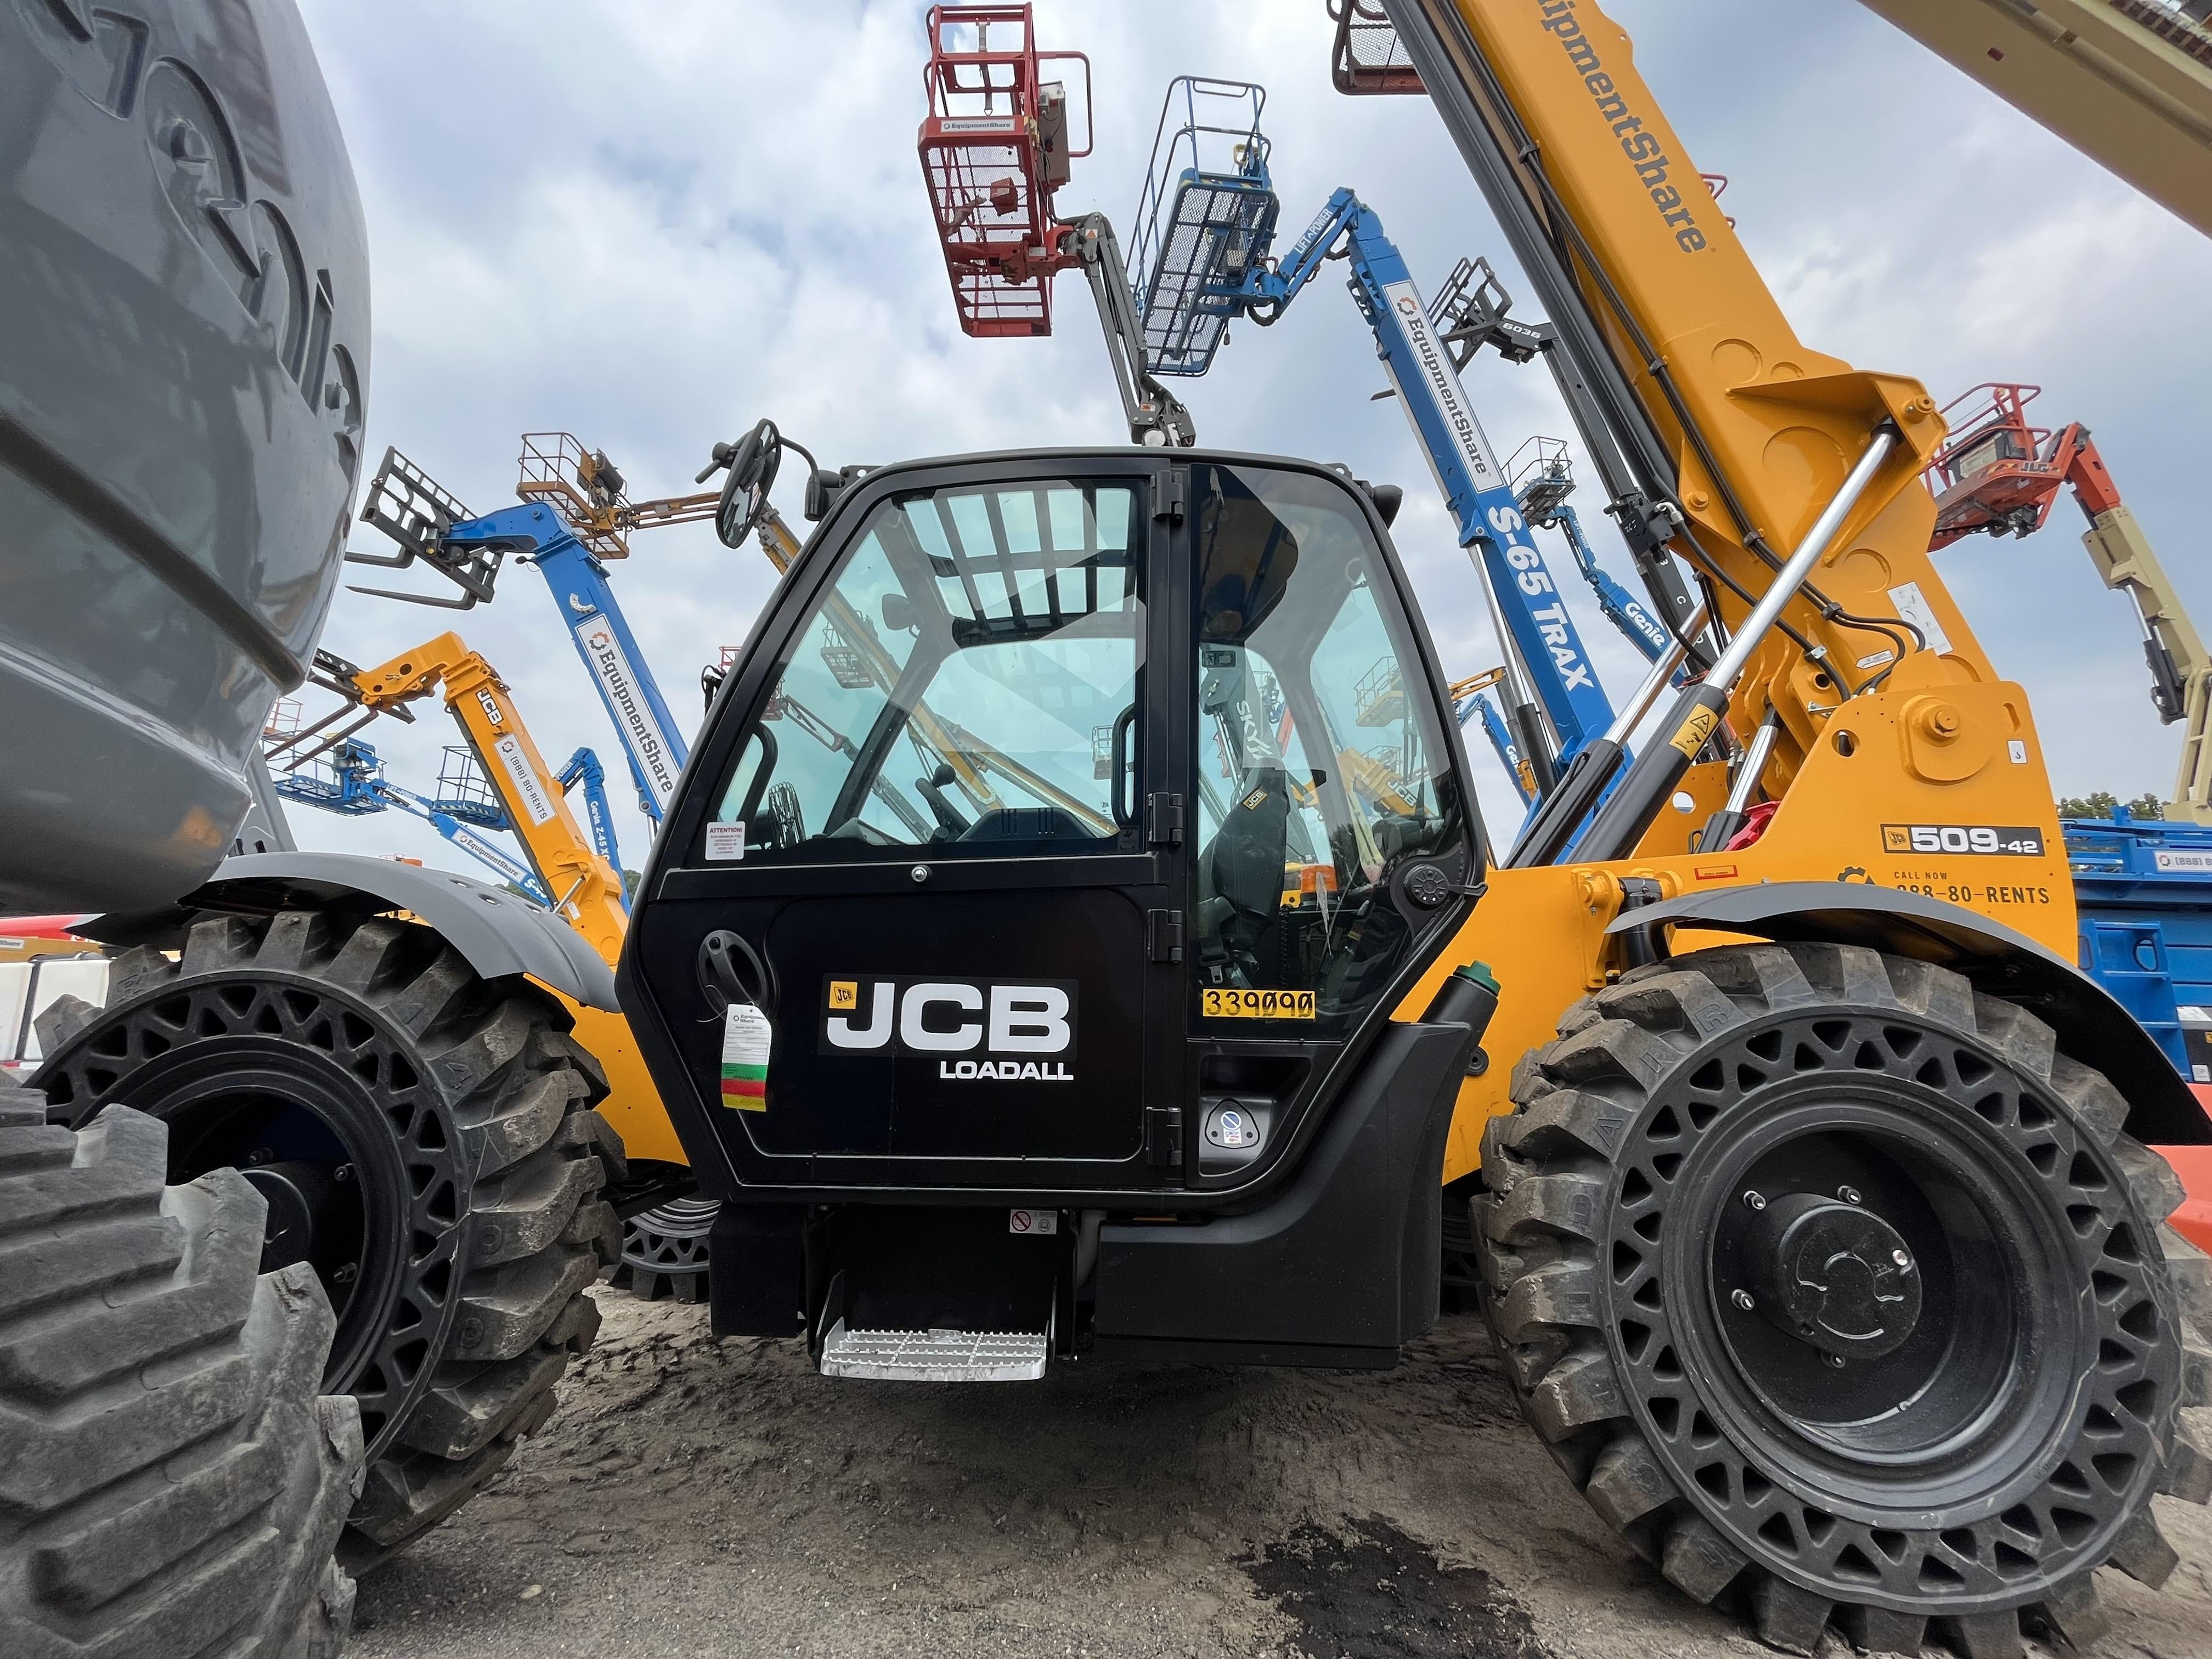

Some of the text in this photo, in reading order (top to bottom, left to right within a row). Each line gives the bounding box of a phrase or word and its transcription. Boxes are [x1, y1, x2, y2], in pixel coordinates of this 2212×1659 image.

[1538, 0, 1707, 253] ipmentShare
[1294, 208, 1333, 254] LIFT POWER
[1503, 322, 1541, 338] 6036
[1408, 317, 1487, 474] EquipmentShare
[2019, 462, 2049, 473] JLG
[1488, 506, 1594, 692] S-65 TRAX
[1625, 602, 1665, 646] Genie
[476, 688, 503, 725] JCB
[599, 650, 674, 792] EquipmentShare
[555, 761, 573, 780] POWER
[510, 756, 548, 819] (888) 80-RENTS
[1248, 789, 1264, 806] JCB
[1387, 780, 1417, 807] JCB
[590, 801, 599, 825] Genie
[1910, 827, 2039, 854] 509-42
[466, 839, 519, 877] EquipmentShare
[2175, 857, 2203, 866] (888)
[1894, 871, 1948, 881] CALL NOW
[837, 987, 853, 1002] JCB
[827, 982, 1071, 1053] JCB
[940, 1061, 1074, 1081] LOADALL
